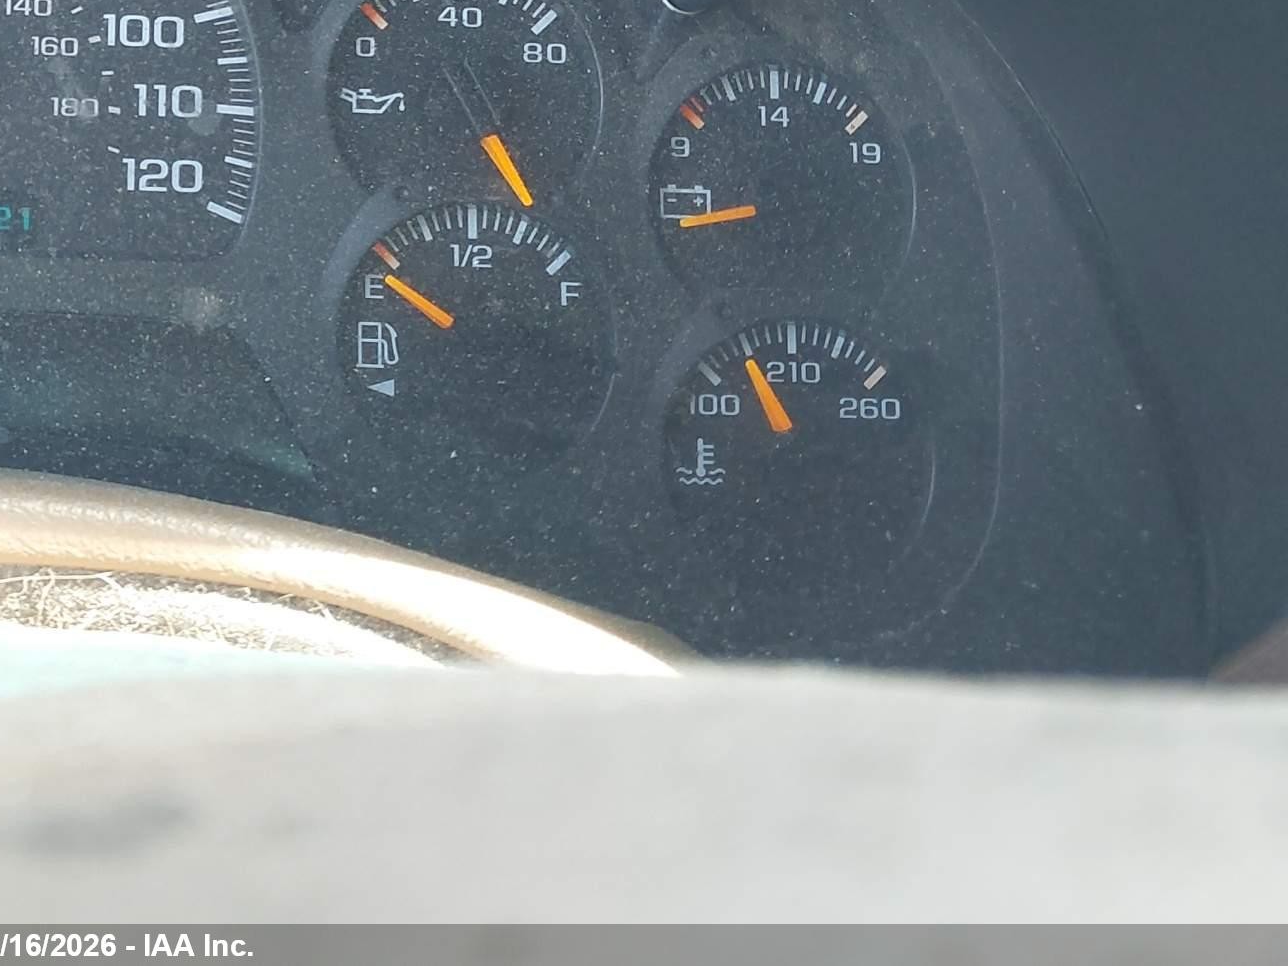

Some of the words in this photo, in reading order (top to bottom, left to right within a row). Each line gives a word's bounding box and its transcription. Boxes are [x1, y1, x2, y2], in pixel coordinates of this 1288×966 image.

[437, 8, 483, 27] 40
[106, 14, 185, 47] 100
[31, 35, 78, 56] 160
[355, 38, 376, 57] 0
[522, 43, 567, 63] 80
[51, 97, 99, 118] 180
[133, 84, 203, 118] 110
[757, 105, 790, 127] 14
[670, 137, 690, 157] 9
[849, 143, 881, 164] 19
[121, 158, 204, 192] 120
[450, 244, 493, 268] 1/2
[365, 274, 385, 299] E
[560, 281, 583, 306] F
[766, 362, 821, 384] 210
[689, 394, 740, 416] 100
[838, 397, 901, 420] 260
